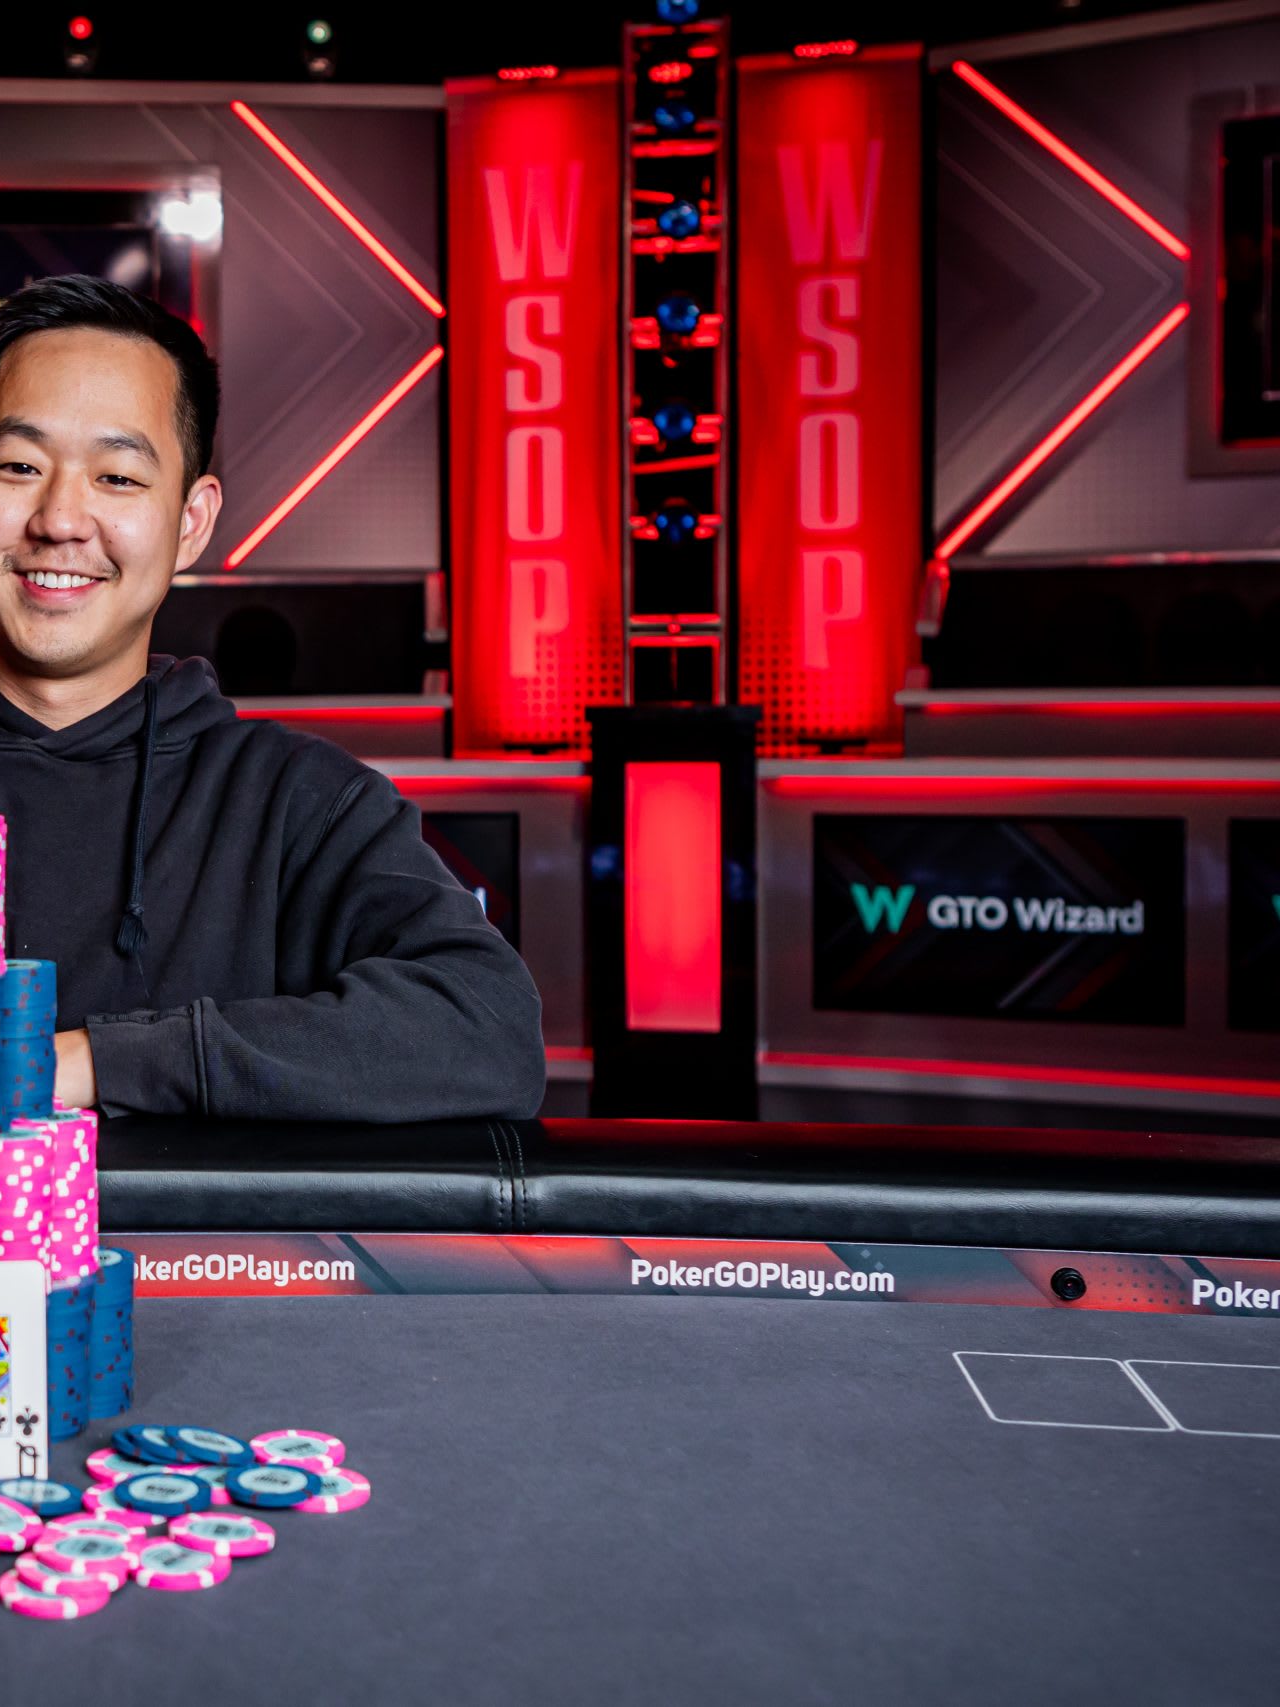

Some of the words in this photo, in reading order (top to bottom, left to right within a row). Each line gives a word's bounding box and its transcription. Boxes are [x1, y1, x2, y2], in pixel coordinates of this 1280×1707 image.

[484, 160, 583, 678] WSOP
[776, 140, 883, 669] WSOP
[926, 895, 1008, 930] GTO
[1014, 898, 1144, 933] Wizard
[631, 1259, 895, 1296] PokerGOPlay.com
[1192, 1279, 1280, 1310] Poker
